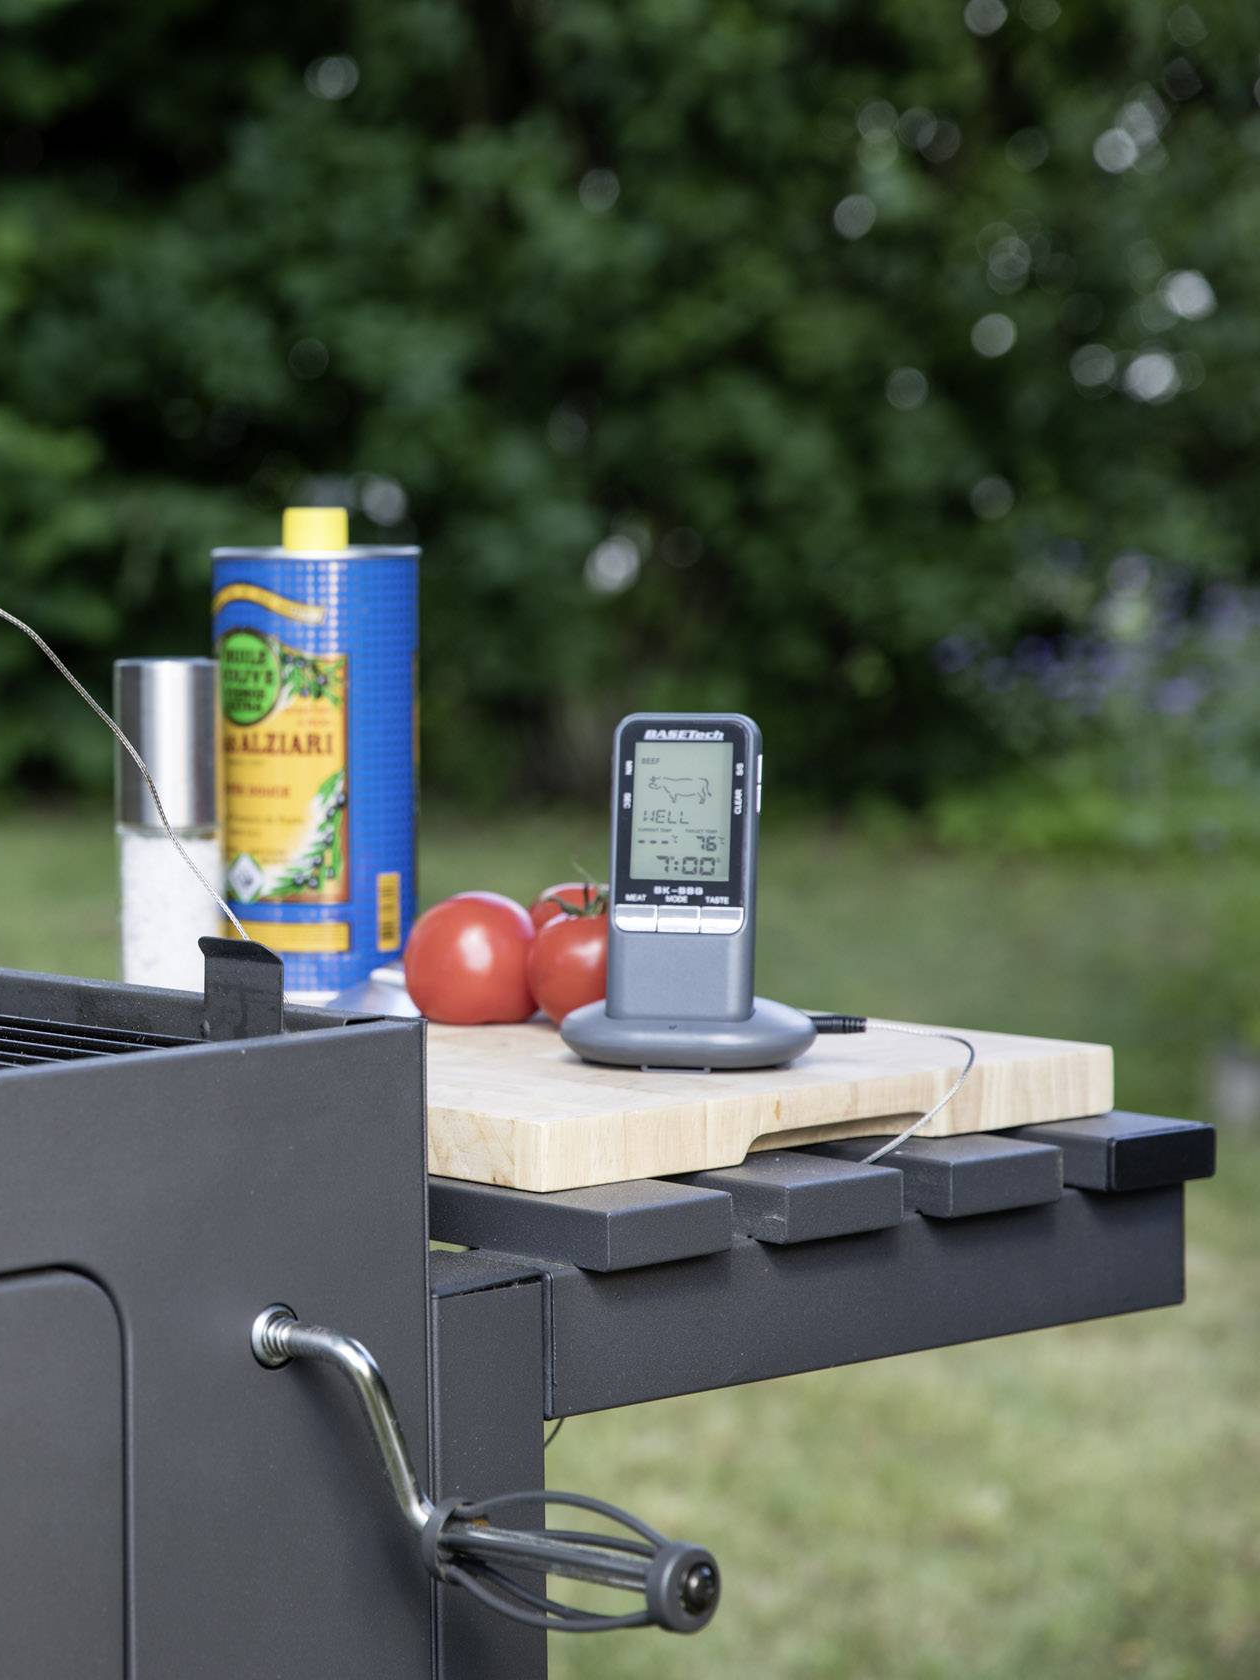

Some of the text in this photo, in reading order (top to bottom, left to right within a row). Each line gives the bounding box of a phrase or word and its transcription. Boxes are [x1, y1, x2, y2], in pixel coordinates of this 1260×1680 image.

[643, 729, 725, 741] BASETech
[696, 835, 717, 851] 76
[656, 855, 715, 876] 7:00
[625, 894, 647, 902] MEAT
[665, 895, 688, 904] MODE
[705, 896, 729, 905] TASTE
